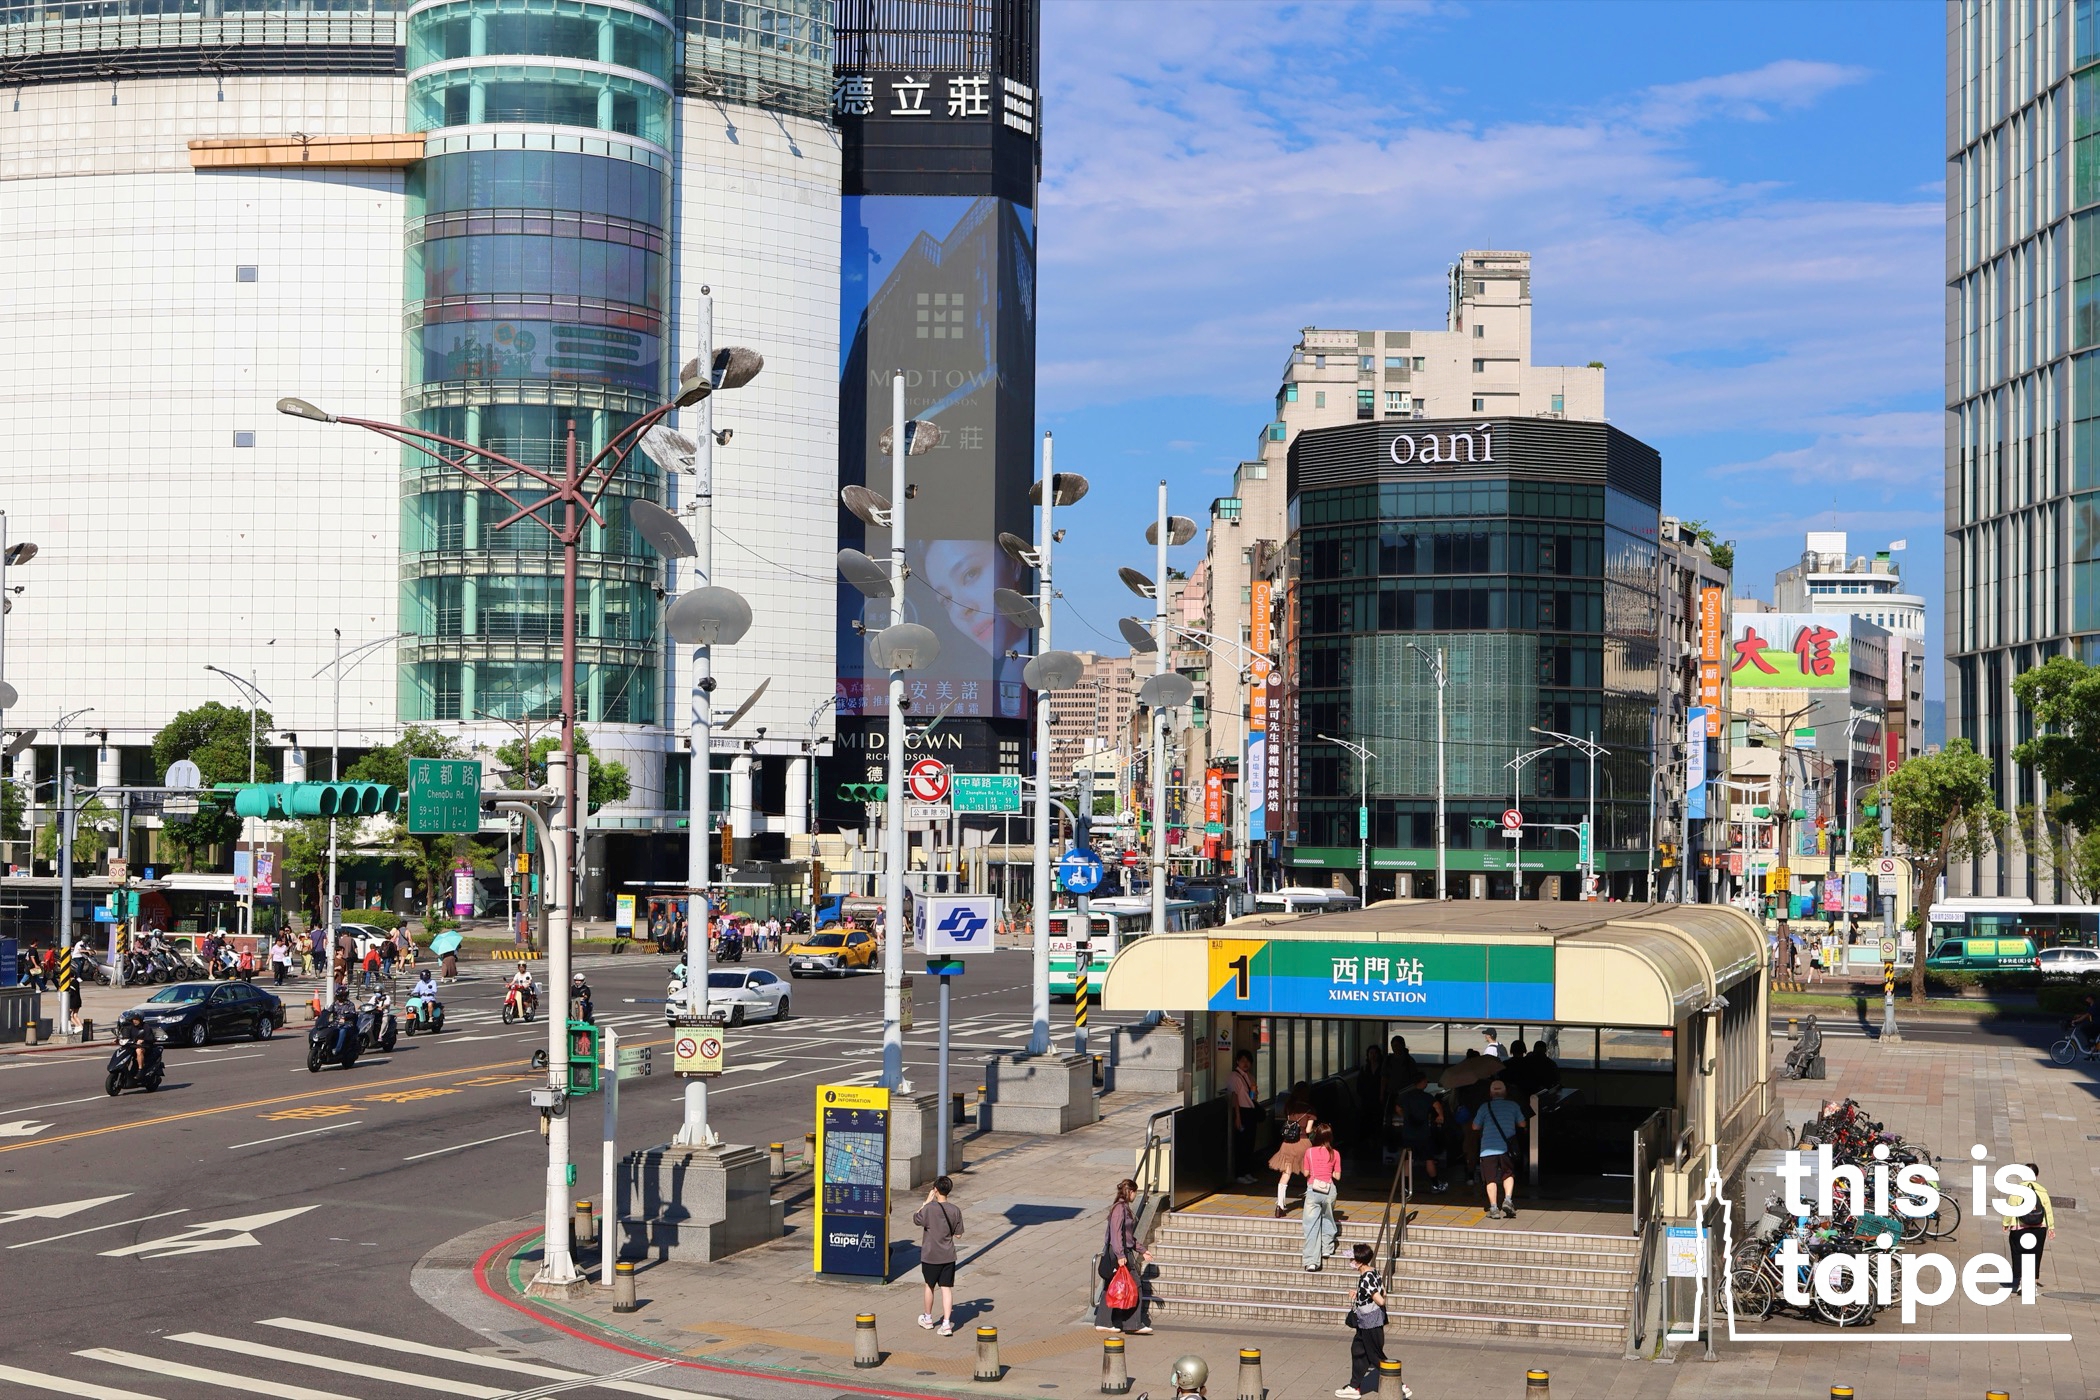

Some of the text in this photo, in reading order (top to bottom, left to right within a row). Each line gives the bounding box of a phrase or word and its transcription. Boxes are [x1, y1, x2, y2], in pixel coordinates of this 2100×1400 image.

[834, 75, 989, 116] 德立莊
[871, 369, 1004, 389] MDTOWN
[934, 426, 983, 450] 立莊
[1257, 584, 1267, 650] CityInn Hotel
[1707, 591, 1718, 657] CityInn Hotel
[1732, 625, 1838, 677] 大信
[910, 681, 979, 700] 安美諾
[837, 732, 963, 749] MIDOWN
[866, 753, 934, 761] RICHDSON
[1268, 699, 1280, 812] 馬可先生雜糧健康烘焙
[418, 763, 474, 786] 成都路
[961, 778, 1012, 788] 中華路一段
[427, 790, 453, 801] ChengDu
[1209, 791, 1218, 820] 康是美
[913, 808, 947, 816] 公車除外
[1229, 955, 1247, 997] 1
[1331, 957, 1424, 986] 西門站
[1329, 990, 1426, 1003] XIMEN STATION
[829, 1232, 859, 1247] taipei
